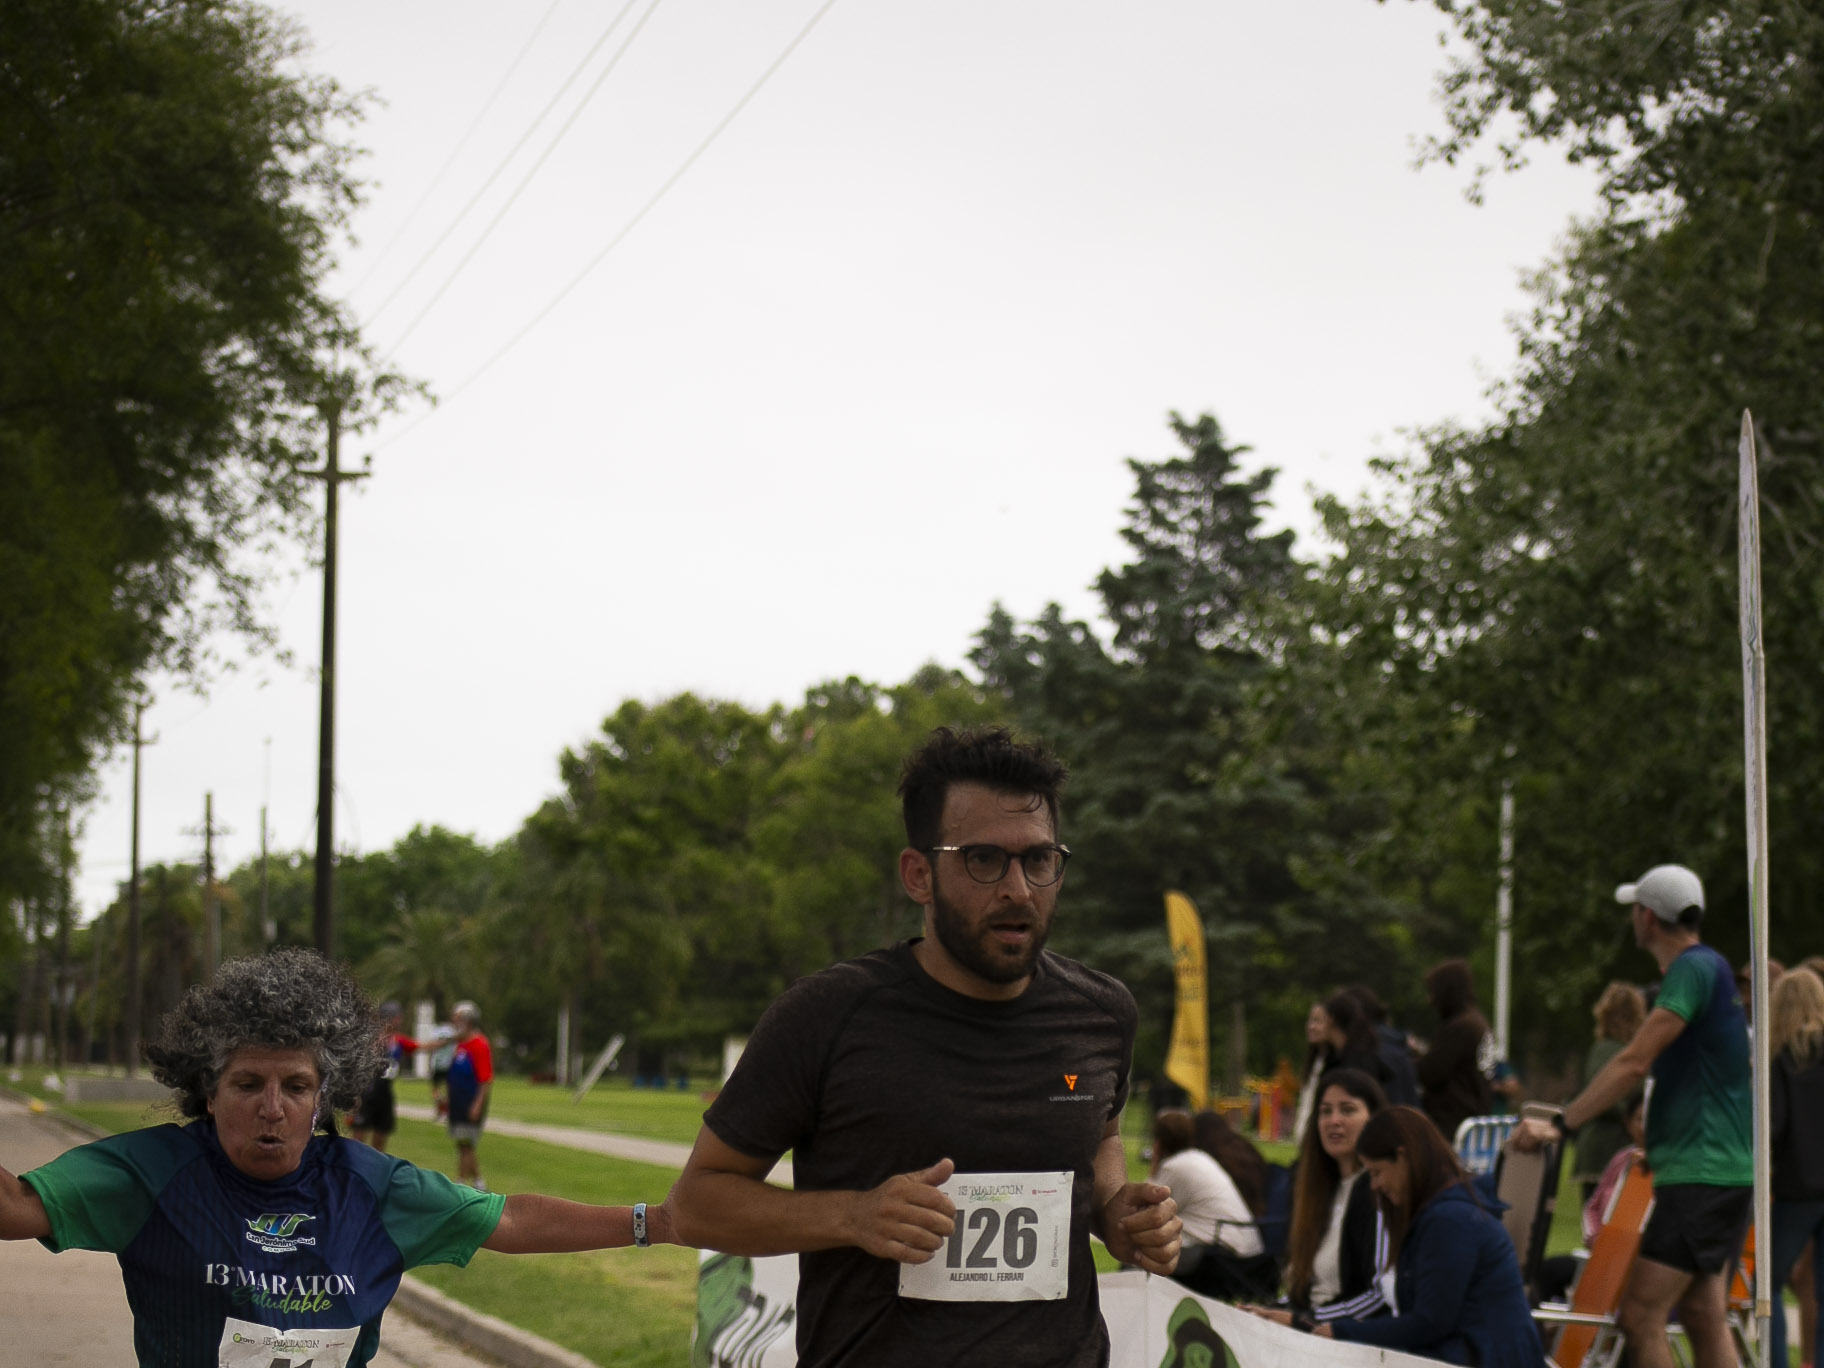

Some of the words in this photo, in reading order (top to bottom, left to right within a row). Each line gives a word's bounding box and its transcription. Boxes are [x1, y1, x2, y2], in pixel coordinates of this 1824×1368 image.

[945, 1207, 1039, 1269] 126
[236, 1265, 356, 1296] MARATON
[949, 1272, 988, 1282] ALEJANDRO
[997, 1272, 1024, 1282] FERRARI
[232, 1286, 333, 1314] Saludable
